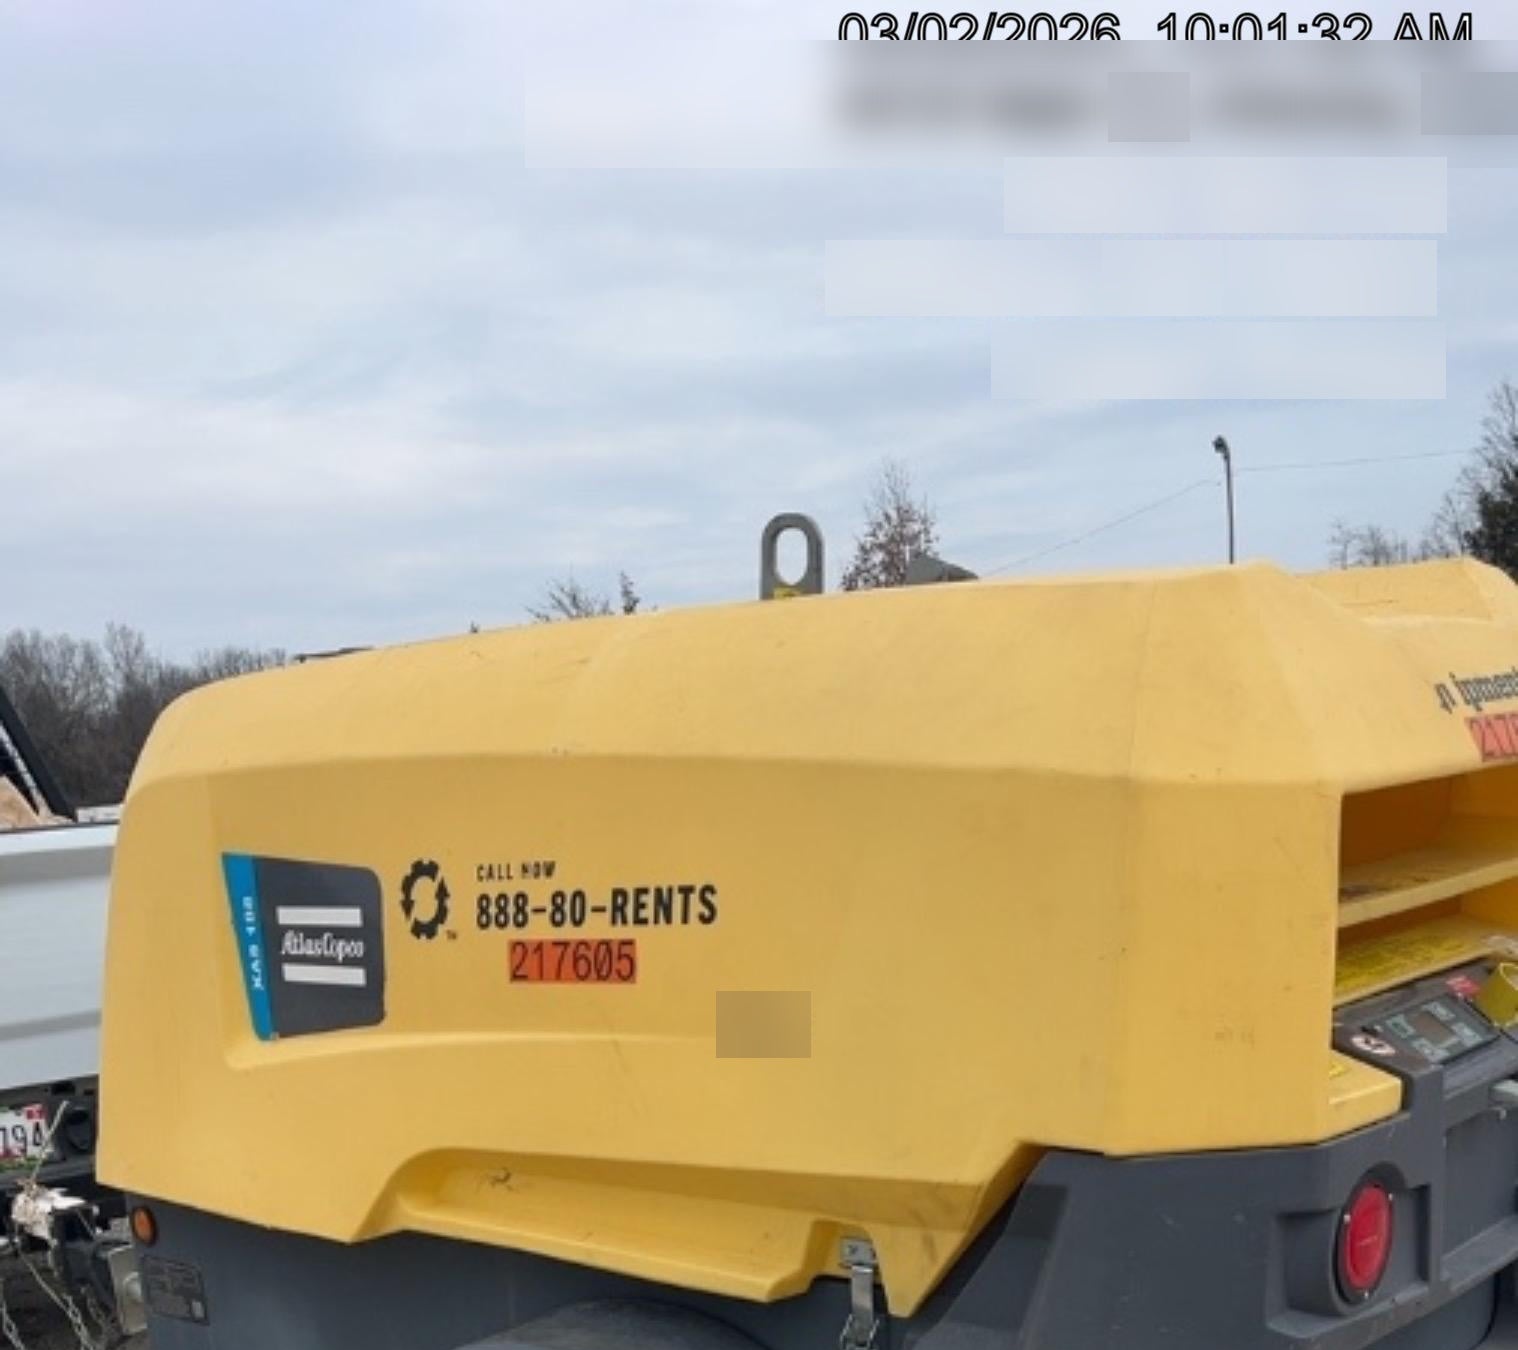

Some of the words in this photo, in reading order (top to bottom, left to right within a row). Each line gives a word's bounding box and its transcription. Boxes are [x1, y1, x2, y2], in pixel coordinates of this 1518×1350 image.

[476, 864, 514, 882] CALL
[521, 861, 556, 880] NOW
[476, 884, 718, 930] 888-80-RENTS
[511, 940, 635, 981] 217605
